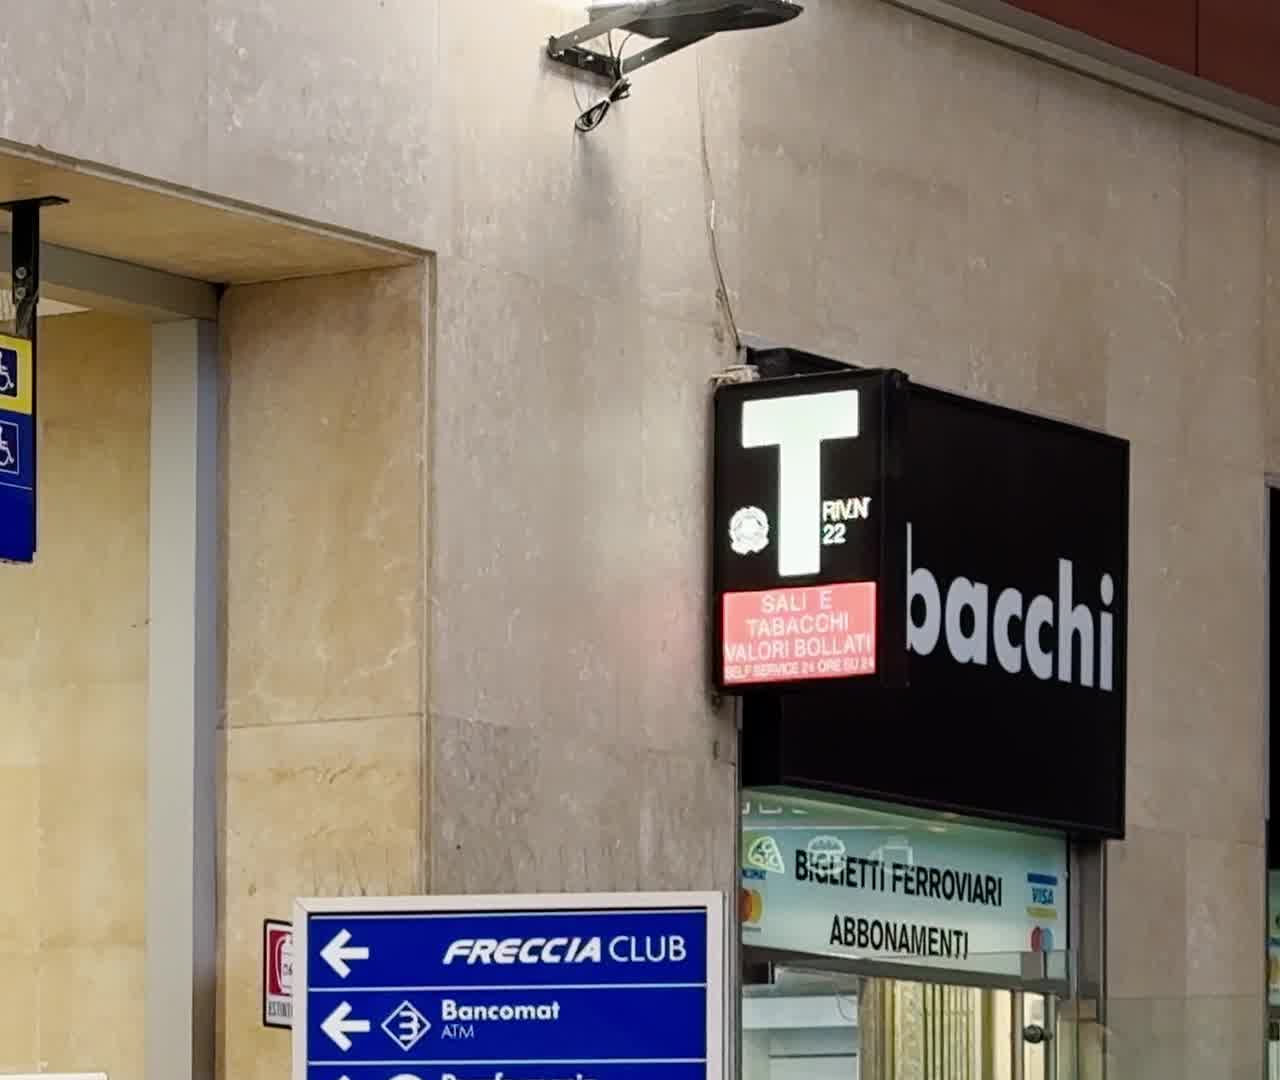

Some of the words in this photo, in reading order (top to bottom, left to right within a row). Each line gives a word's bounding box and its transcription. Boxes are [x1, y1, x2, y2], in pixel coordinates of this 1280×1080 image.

[742, 389, 860, 577] T
[823, 522, 846, 545] 22
[761, 591, 807, 614] SALI
[820, 589, 833, 610] E
[744, 611, 849, 638] TABACCHI
[724, 639, 790, 663] VALORI
[794, 633, 872, 658] BOLLATI
[795, 849, 885, 892] BIGLIETTI
[892, 862, 1003, 907] FERROVIARI
[1031, 886, 1054, 905] VISA
[442, 936, 603, 965] FRECCIA
[609, 935, 687, 963] CLUB
[829, 914, 969, 960] ABBONAMENTI
[442, 1000, 560, 1021] Bancomat
[441, 1024, 474, 1039] ATM
